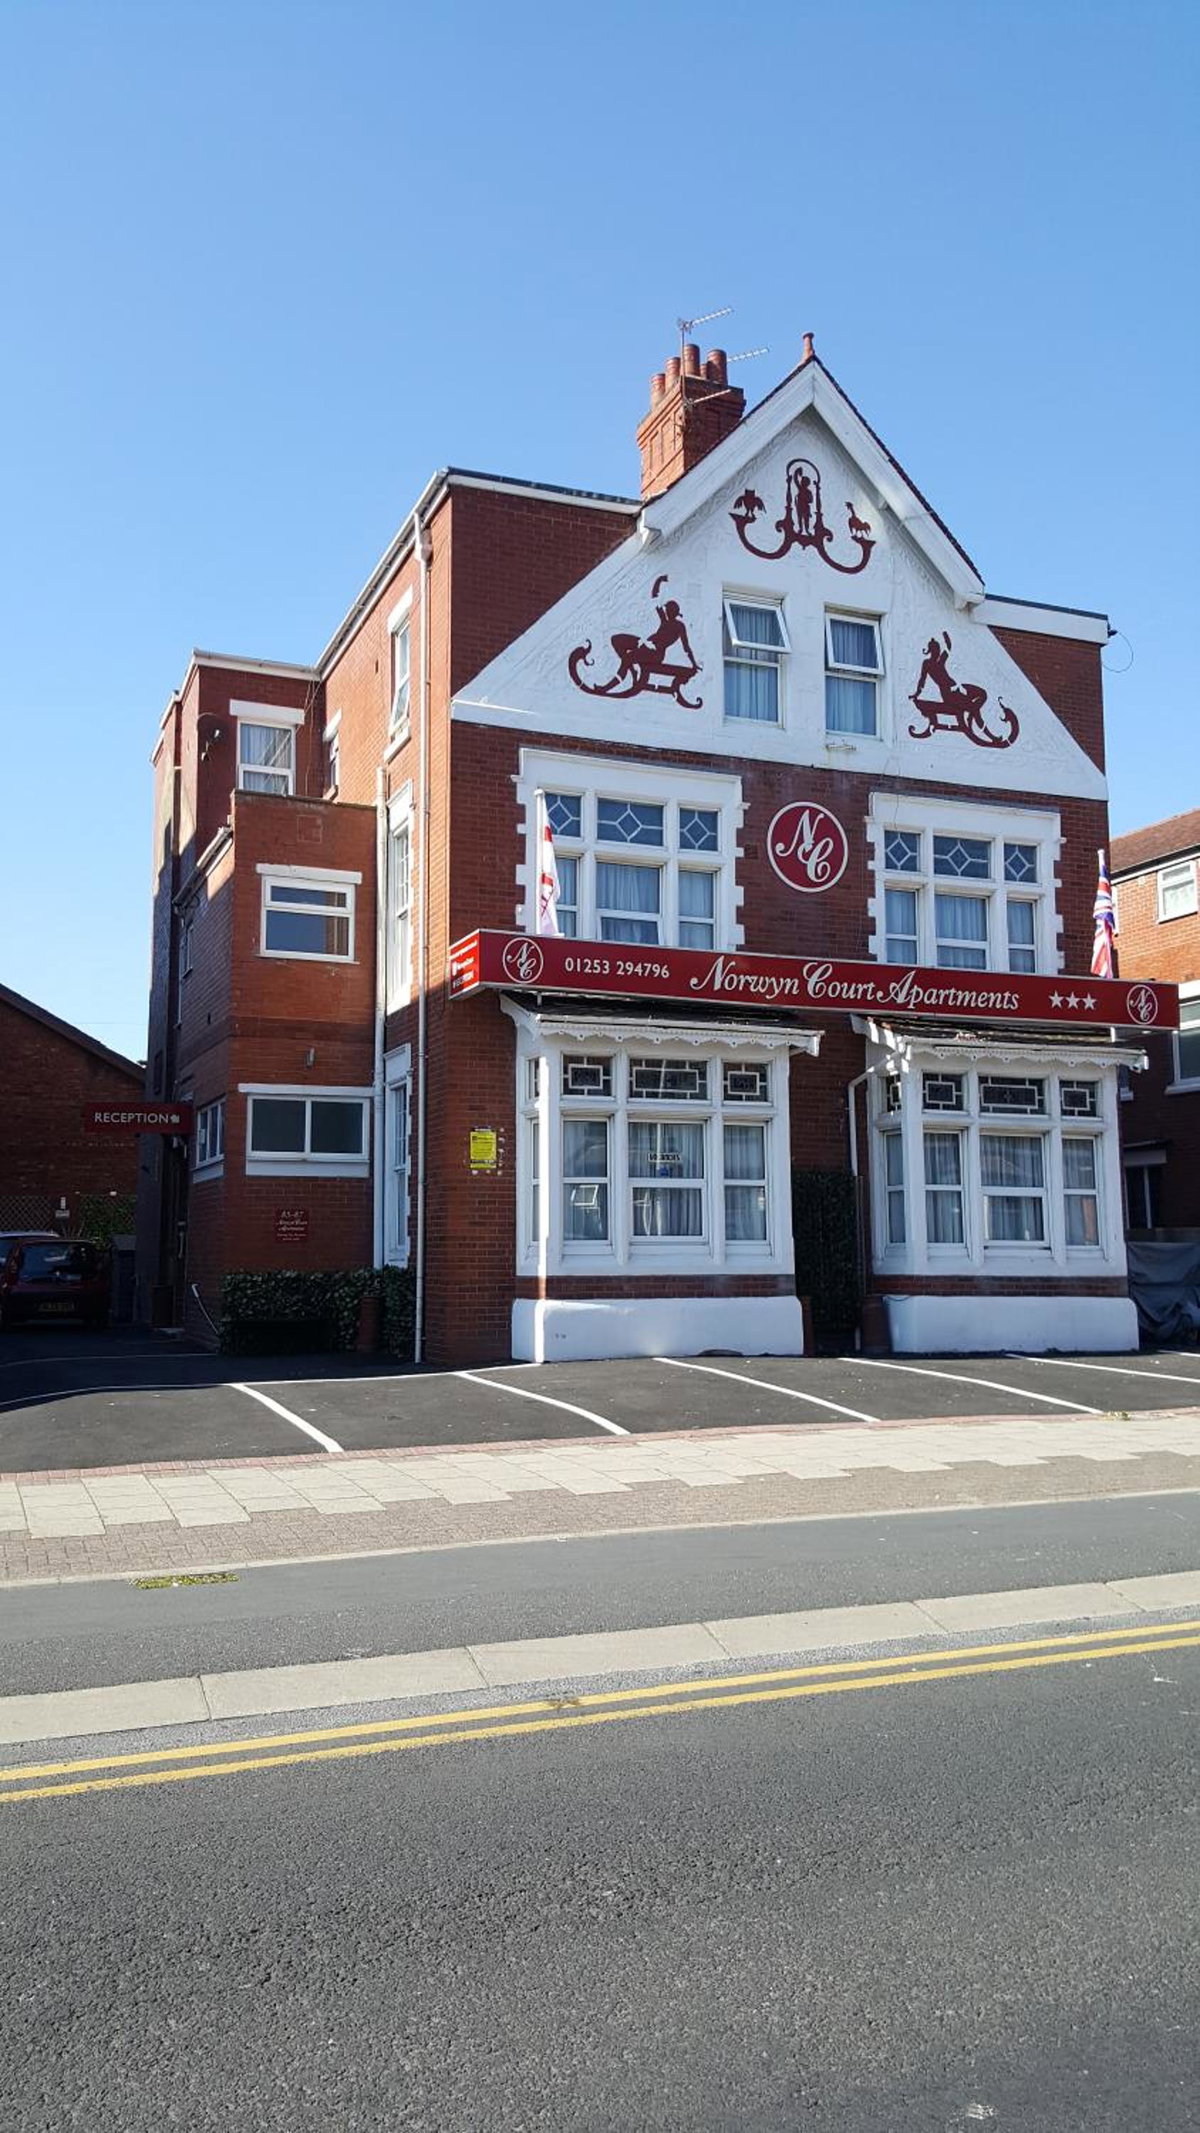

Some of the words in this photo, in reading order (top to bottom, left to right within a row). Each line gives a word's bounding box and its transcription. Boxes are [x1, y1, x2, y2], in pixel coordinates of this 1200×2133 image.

[564, 957, 610, 975] 01253
[616, 960, 670, 979] 294796
[689, 955, 800, 1000] Norwyn
[802, 962, 876, 1000] Court
[876, 970, 1020, 1010] Apartments
[94, 1112, 169, 1124] RECEPTION
